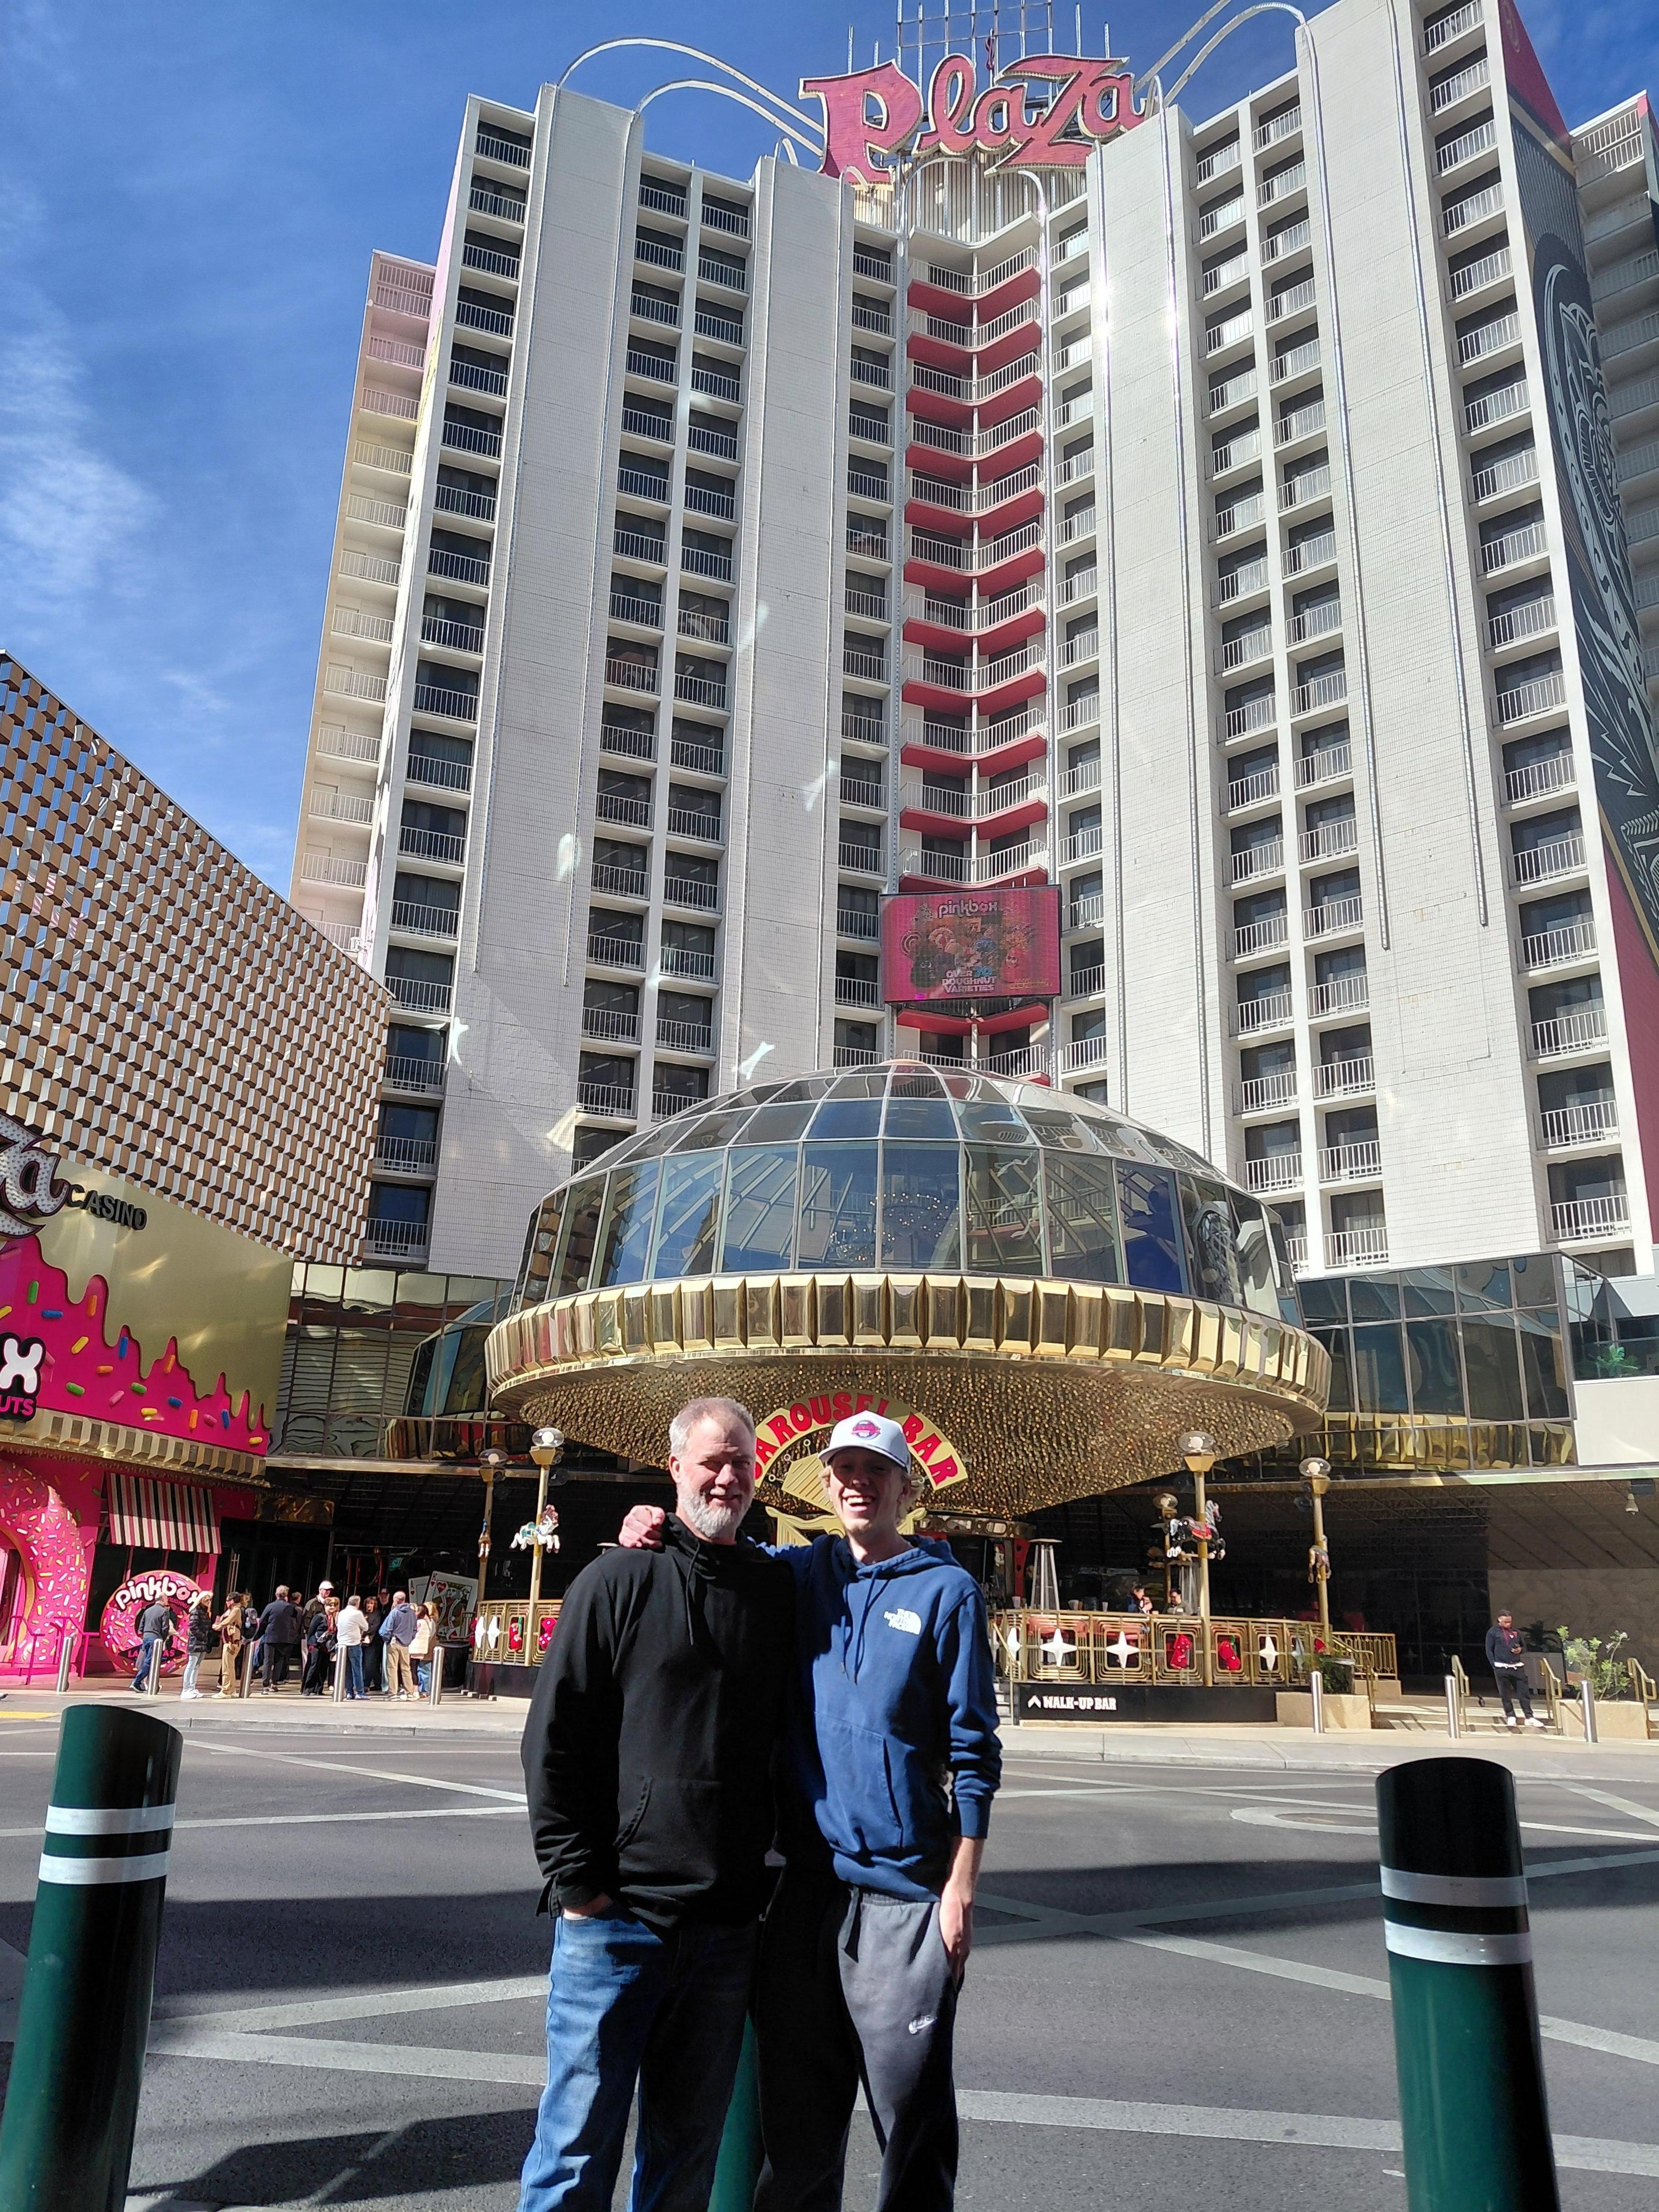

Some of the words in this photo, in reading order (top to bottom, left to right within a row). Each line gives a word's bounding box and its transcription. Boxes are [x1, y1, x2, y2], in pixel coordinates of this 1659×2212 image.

[938, 899, 999, 918] pinkbox
[942, 976, 996, 985] DOUGHNUT
[946, 969, 973, 978] OVER
[943, 985, 995, 993] VARIETIES
[66, 1184, 147, 1230] CASINO
[902, 1412, 959, 1486] BAR
[1042, 1695, 1094, 1710] WALK-UP
[1094, 1697, 1117, 1711] BAR
